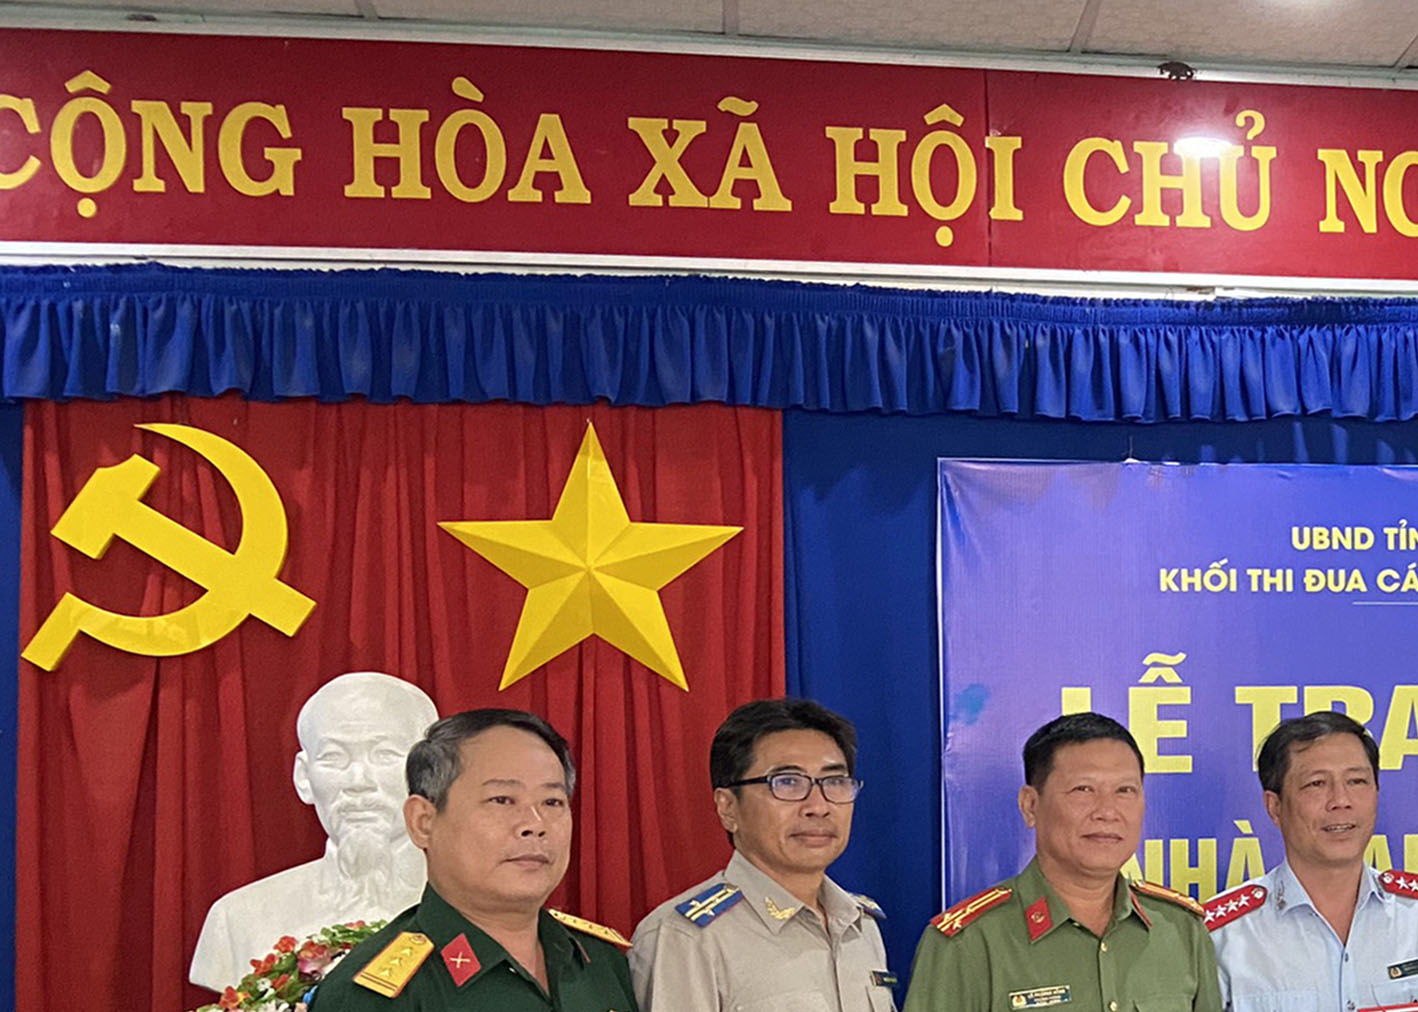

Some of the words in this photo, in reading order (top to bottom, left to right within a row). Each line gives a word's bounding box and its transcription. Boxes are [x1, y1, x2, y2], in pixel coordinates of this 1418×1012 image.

[343, 77, 592, 205] HÒA
[627, 96, 792, 213] XÃ
[826, 103, 1024, 248] HỘI
[1062, 109, 1278, 232] CHỦ
[1291, 526, 1375, 551] UBND
[1159, 558, 1237, 592] KHỐI
[1246, 568, 1294, 592] THI
[1303, 568, 1368, 592] ĐUA
